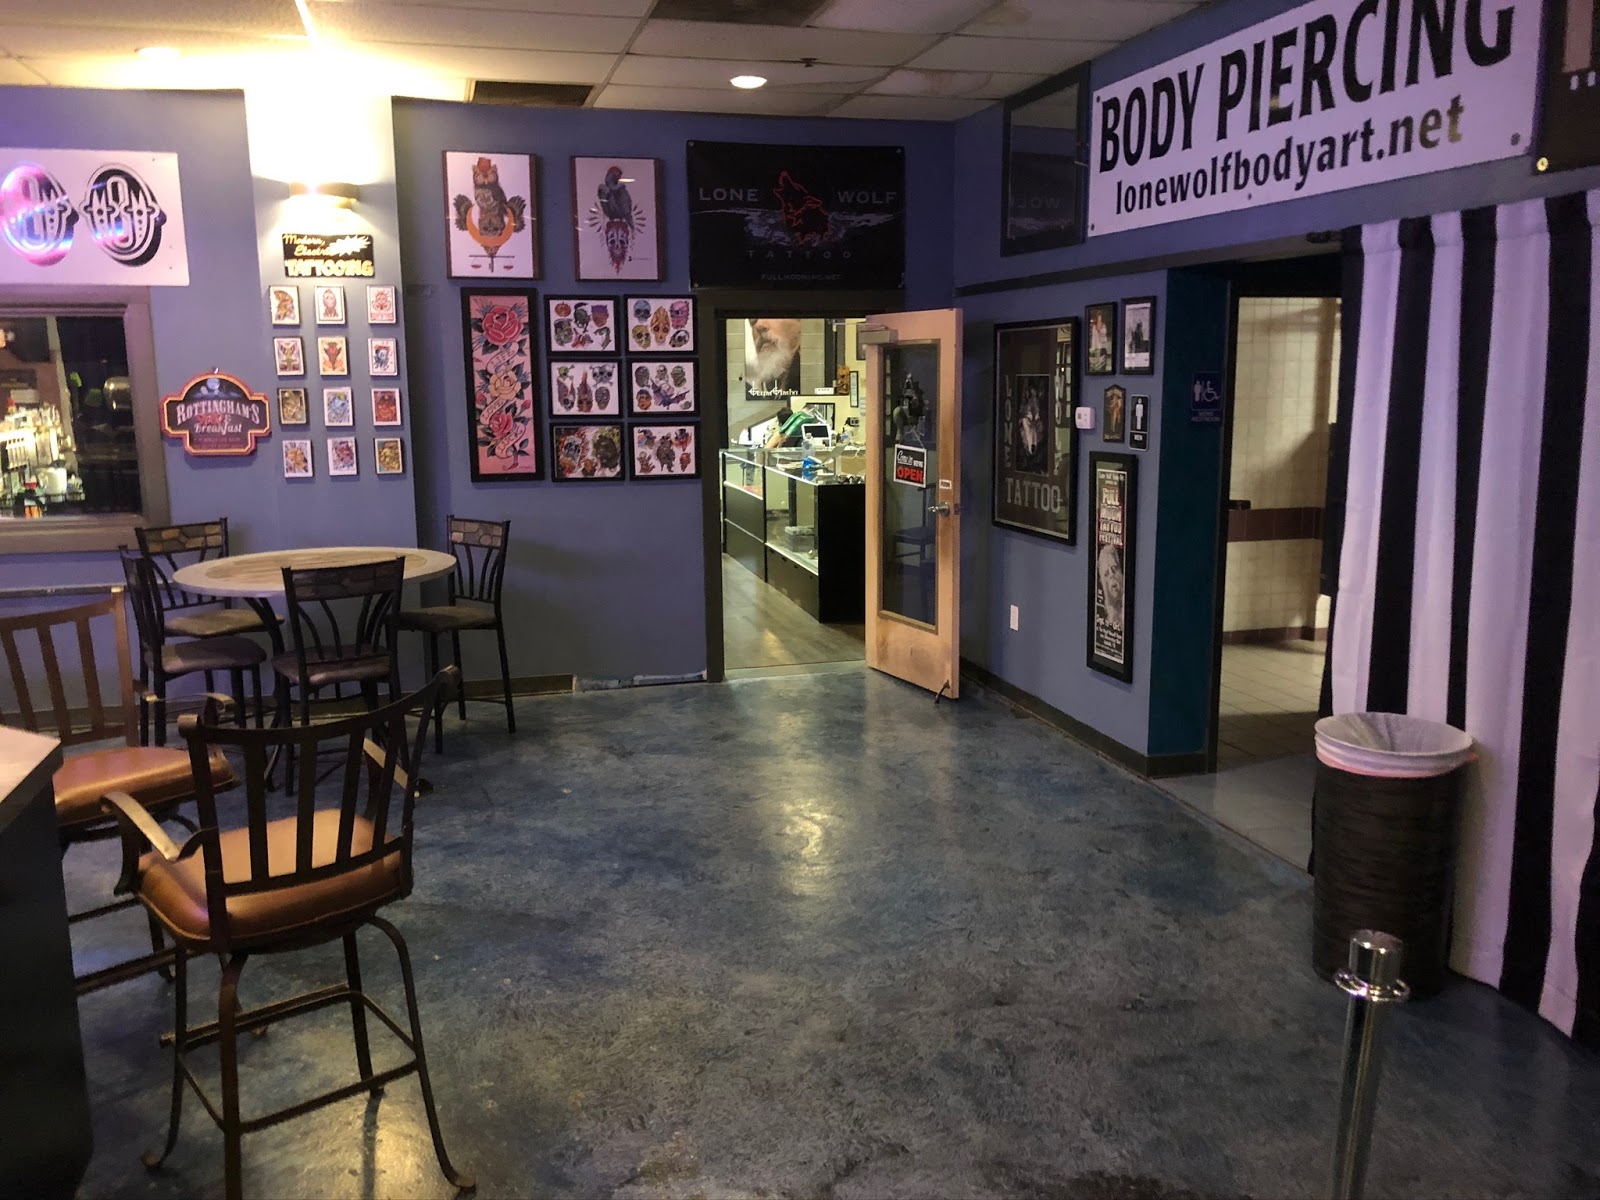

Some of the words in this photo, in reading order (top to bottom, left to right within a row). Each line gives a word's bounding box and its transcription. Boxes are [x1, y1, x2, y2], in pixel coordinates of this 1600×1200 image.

[1099, 62, 1206, 174] BODY
[1216, 0, 1515, 142] PIERCING
[1115, 94, 1466, 216] lonewolfbodyart.net
[698, 187, 760, 202] LONE
[837, 190, 898, 204] WOLF
[284, 259, 374, 277] TATTOOING
[747, 249, 853, 260] TATTOO
[175, 399, 260, 426] ROTTINGHAM'S
[1003, 374, 1014, 468] LONE
[896, 466, 924, 482] OPEN
[1005, 477, 1062, 515] TATTOO
